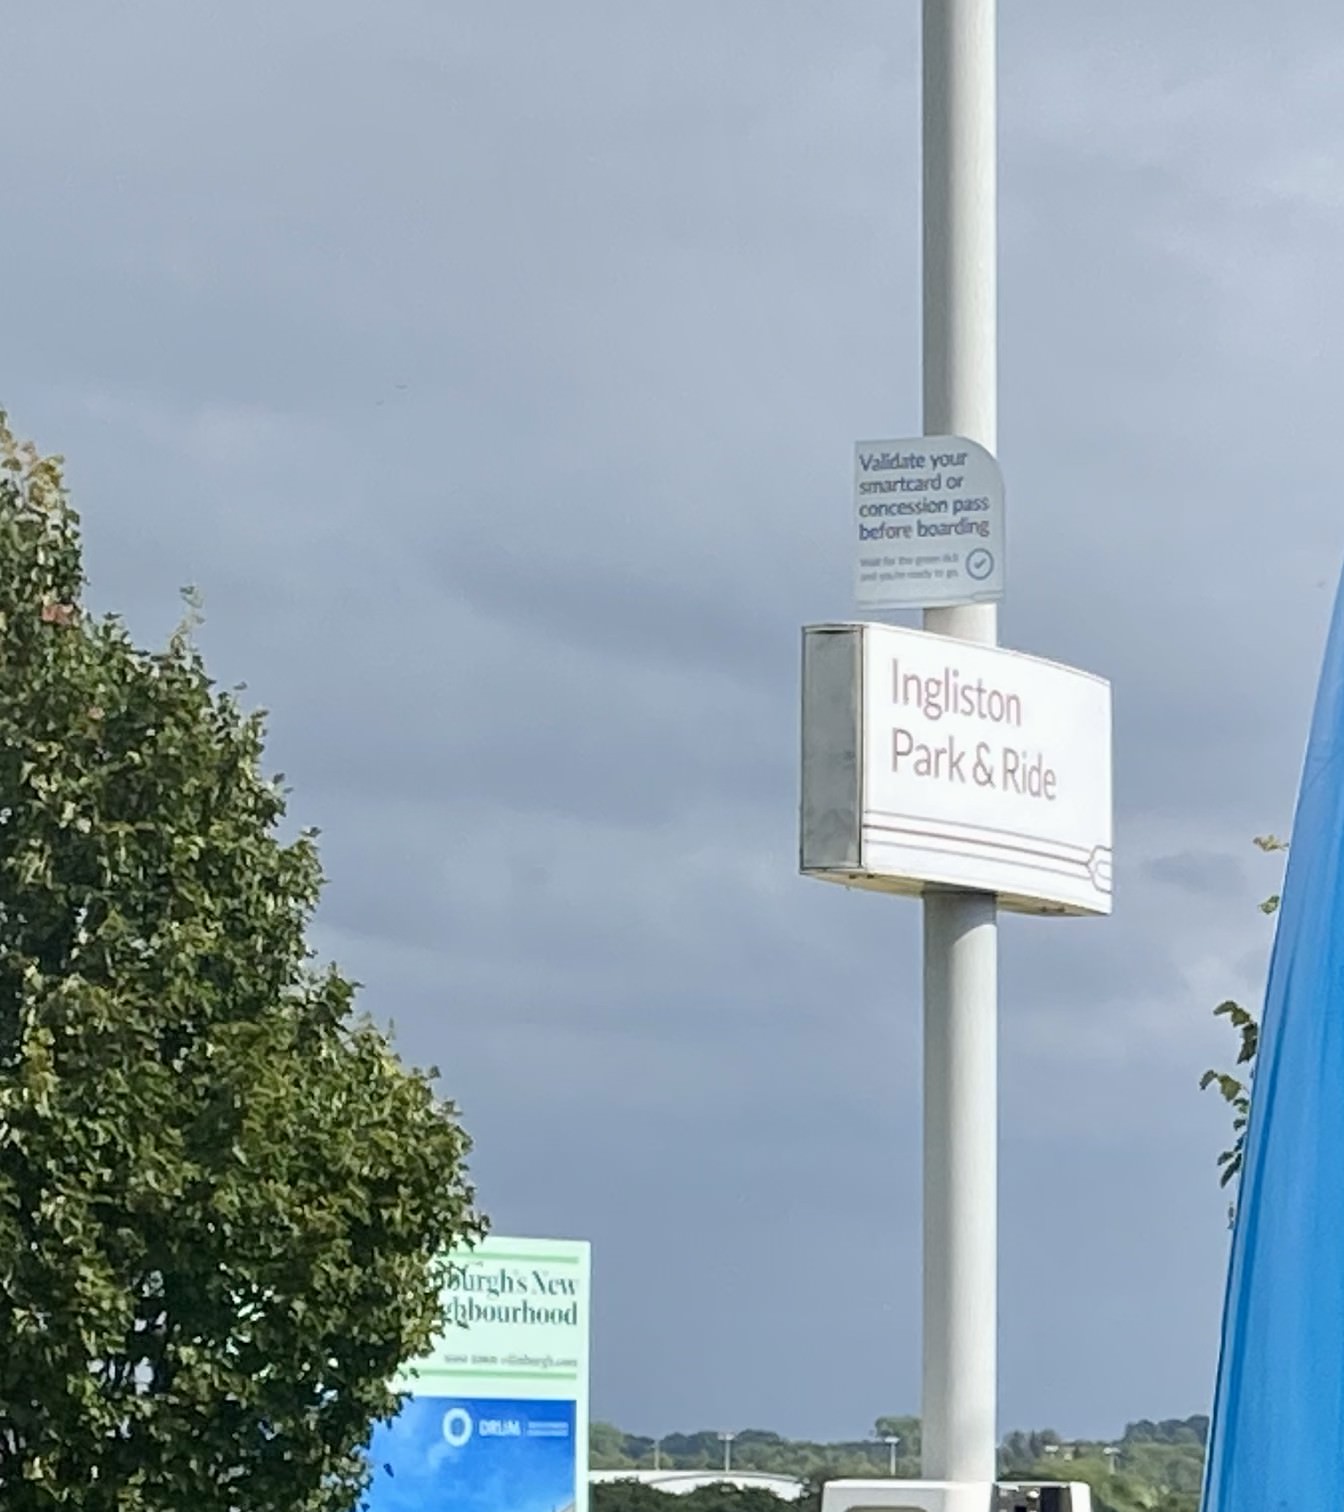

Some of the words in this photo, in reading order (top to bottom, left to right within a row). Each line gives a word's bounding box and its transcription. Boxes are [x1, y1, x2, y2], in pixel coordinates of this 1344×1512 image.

[859, 452, 926, 471] Validate
[930, 452, 968, 471] your
[859, 473, 941, 495] smartcard
[946, 475, 964, 490] or
[859, 497, 948, 518] concession
[952, 496, 990, 516] pass
[859, 521, 912, 540] before
[916, 517, 990, 538] boarding
[891, 658, 1022, 728] Ingliston
[892, 727, 966, 785] Park
[972, 741, 995, 788] &
[1002, 747, 1057, 801] Ride
[448, 1268, 528, 1299] burgh's
[532, 1270, 579, 1297] New
